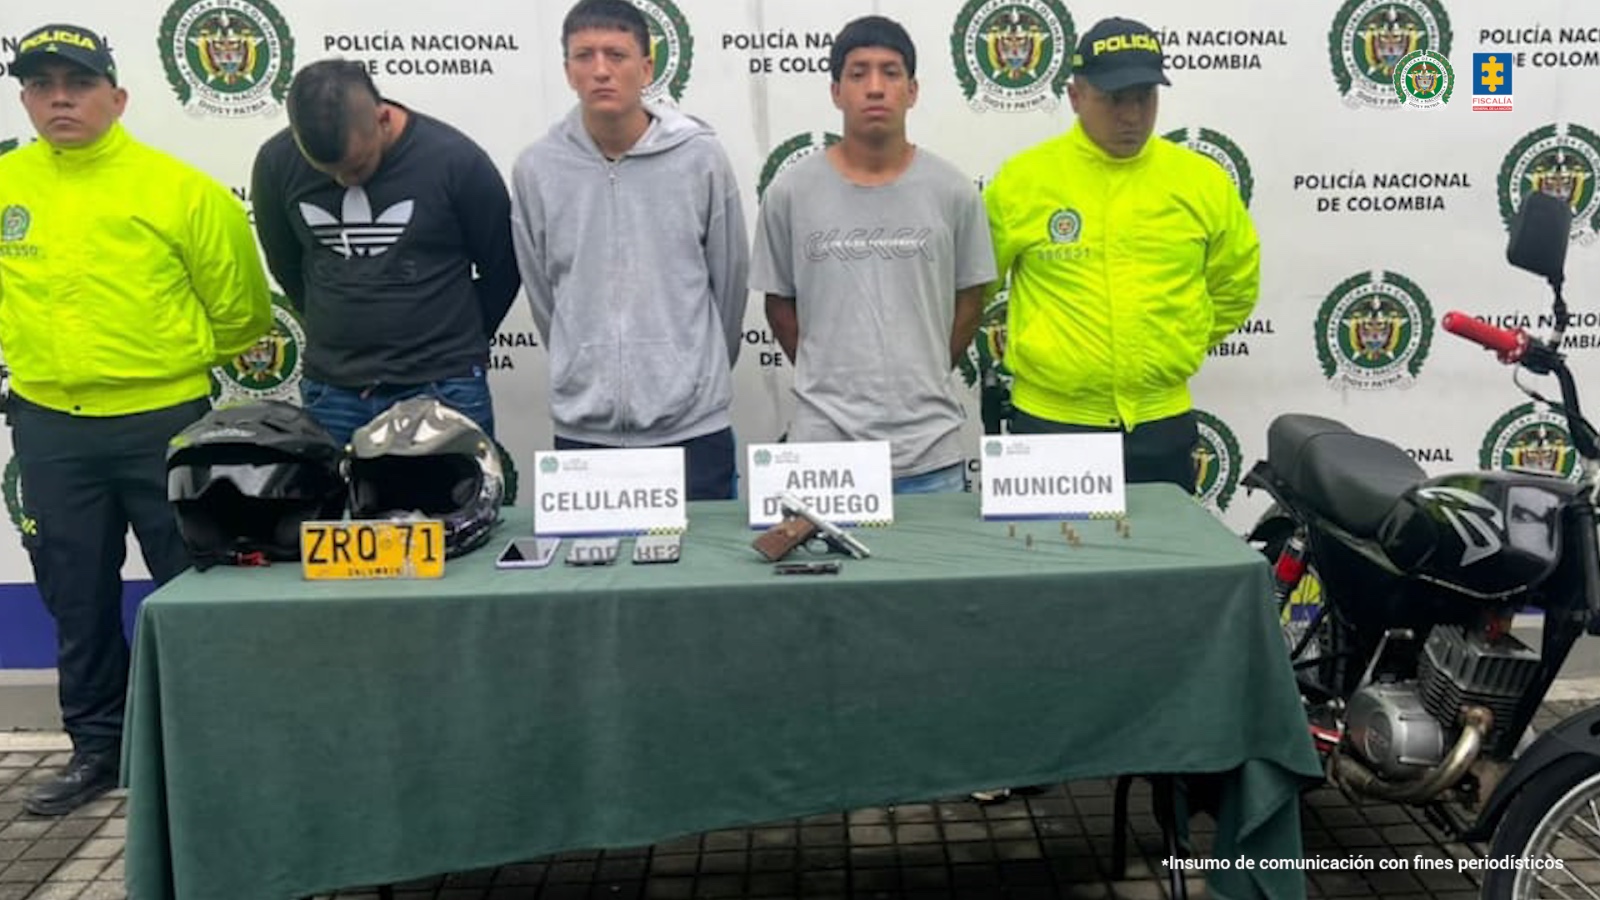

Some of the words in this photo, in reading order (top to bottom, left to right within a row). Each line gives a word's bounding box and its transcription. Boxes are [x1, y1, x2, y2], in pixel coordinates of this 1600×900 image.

[20, 30, 96, 53] POLICIA
[324, 31, 405, 52] POLICÍA
[411, 34, 519, 51] NACIONAL
[723, 28, 799, 50] POLICÍA
[1092, 32, 1160, 56] POLICIA
[1186, 29, 1288, 46] NACIONAL
[1480, 22, 1552, 45] POLICÍA
[386, 59, 494, 75] COLOMBIA
[749, 58, 773, 74] DE
[780, 57, 831, 73] COLO
[1294, 169, 1366, 190] POLICÍA
[1373, 172, 1471, 189] NACIONAL
[1317, 198, 1343, 212] DE
[1347, 195, 1446, 212] COLOMBIA
[760, 352, 783, 367] DE
[786, 469, 855, 489] ARMA
[992, 471, 1113, 496] MUNICIÓN
[541, 488, 678, 513] CELULARES
[396, 525, 437, 562] 71
